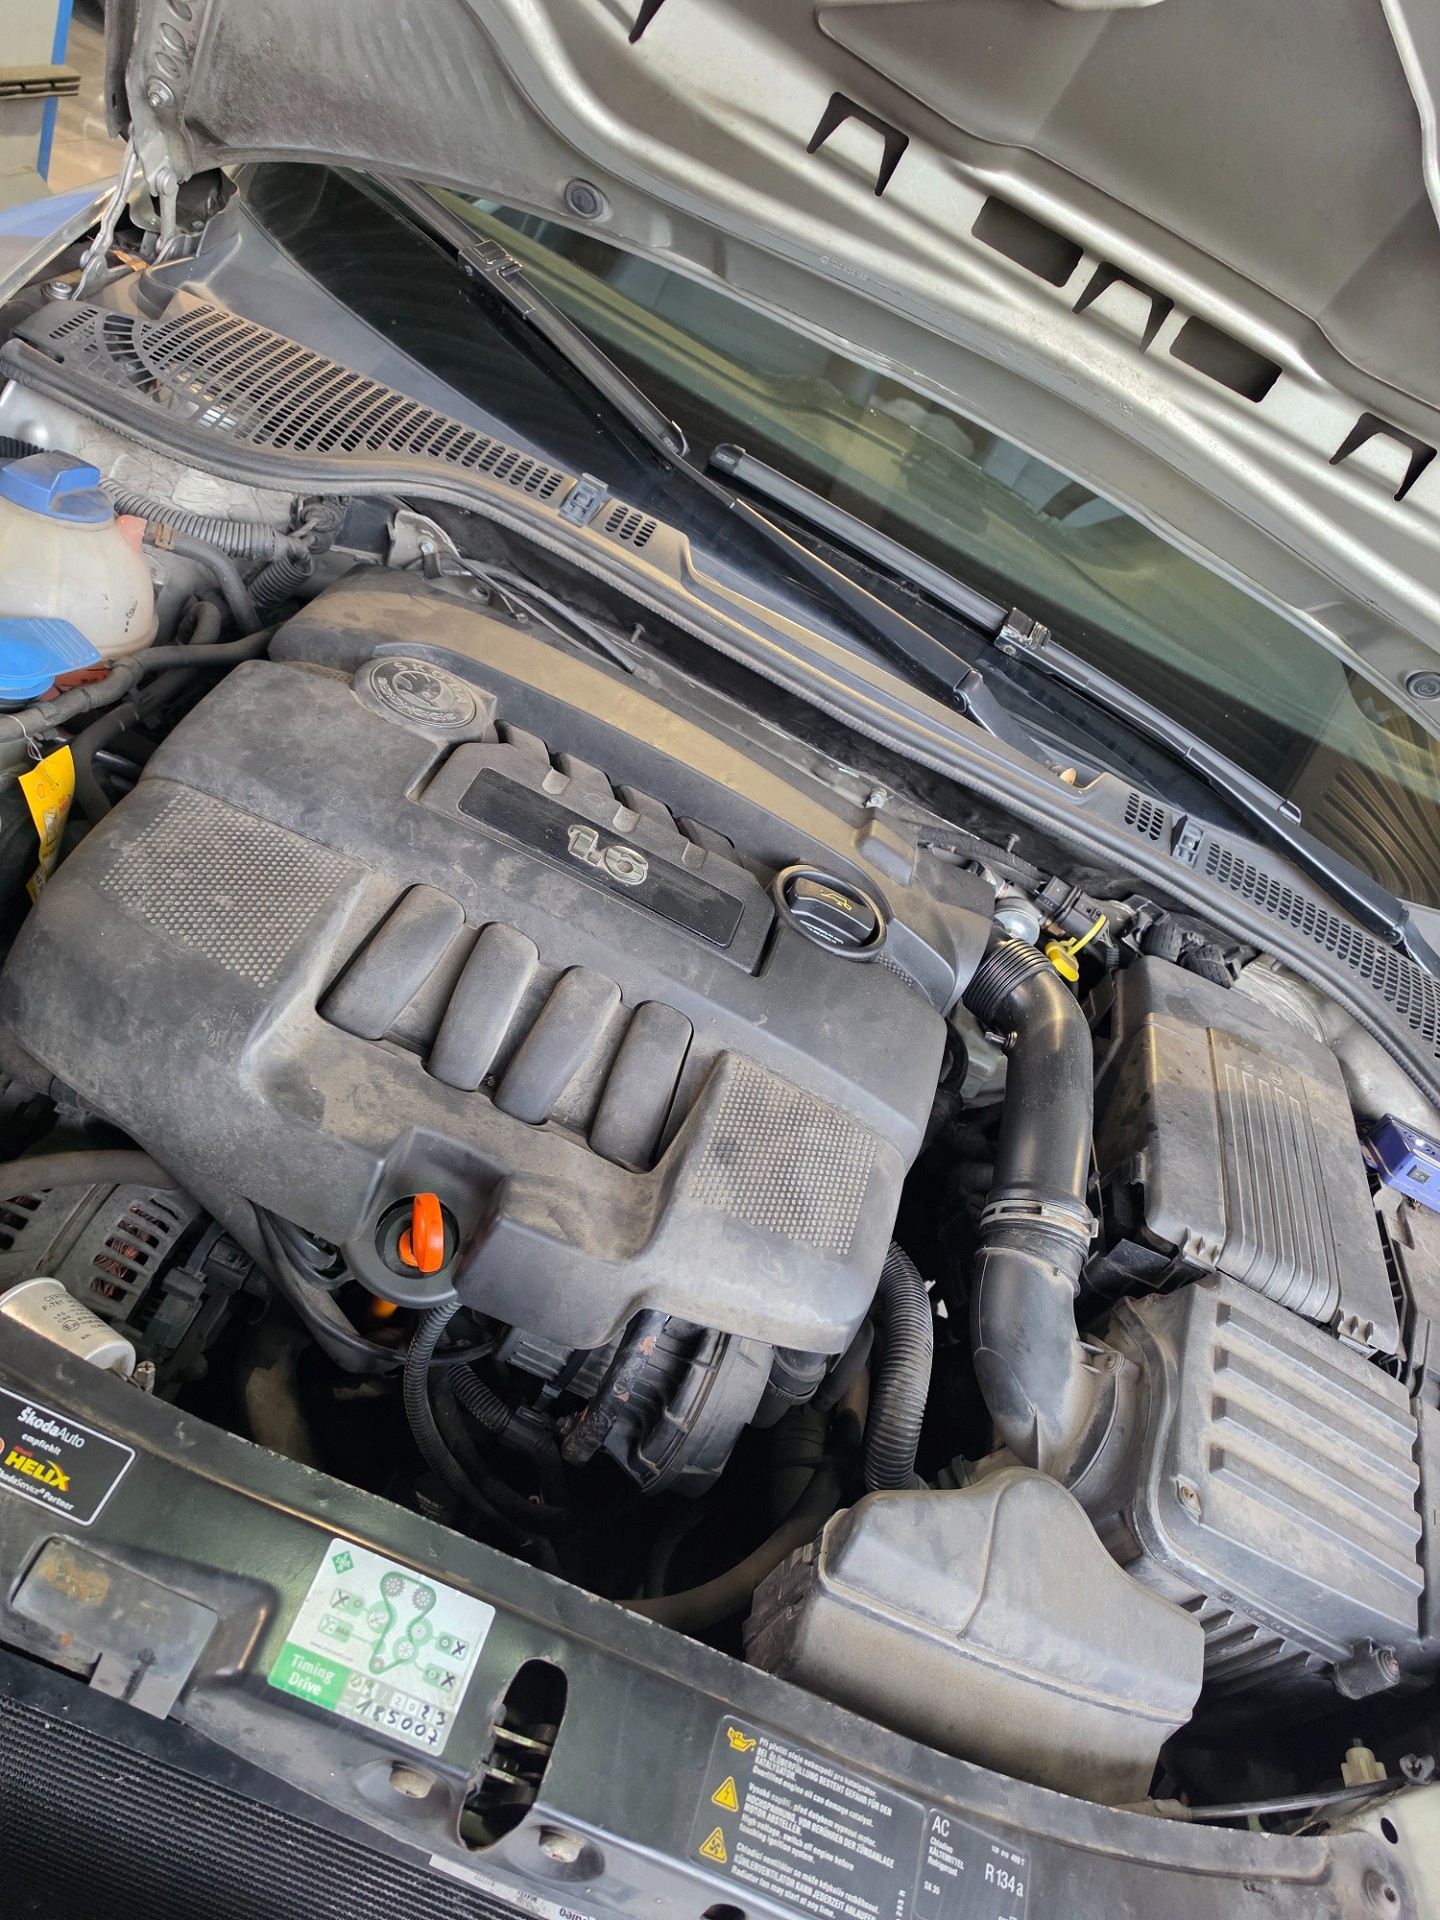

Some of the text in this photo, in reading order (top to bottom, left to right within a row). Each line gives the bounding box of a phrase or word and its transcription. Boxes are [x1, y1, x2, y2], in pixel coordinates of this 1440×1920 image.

[568, 824, 648, 885] 1.6
[21, 1433, 61, 1456] empfiehlt
[4, 1450, 70, 1493] HELIX
[43, 1491, 74, 1511] Partner
[288, 1671, 322, 1697] Drive
[292, 1653, 335, 1685] Timing
[356, 1700, 438, 1745] 185007
[754, 1754, 797, 1781] KATALYSATOR.
[756, 1746, 892, 1816] BEI ÖLÜBERFÜLLUNG BESTEHT GEFAHR FÜR DEN
[833, 1773, 843, 1782] pro
[744, 1802, 766, 1819] MOTOR
[752, 1764, 874, 1828] Overfilled engine oil can damage catalyst.
[797, 1816, 811, 1829] VOR
[843, 1837, 856, 1850] DER
[931, 1815, 950, 1837] AC
[739, 1822, 815, 1864] touching ignition system.
[741, 1812, 756, 1827] High
[783, 1831, 803, 1847] switch
[804, 1840, 812, 1851] off
[813, 1846, 833, 1862] engine
[834, 1855, 854, 1871] before
[927, 1855, 958, 1877] Refrigerant
[928, 1845, 965, 1870] KÄLTEMITTEL
[793, 1869, 800, 1878] se
[731, 1864, 758, 1883] Radiator
[759, 1877, 769, 1889] fan
[770, 1883, 782, 1896] may
[784, 1888, 799, 1902] start
[807, 1900, 817, 1911] any
[819, 1904, 836, 1919] time.
[795, 1880, 812, 1896] KANN
[813, 1889, 843, 1910] JEDERZEIT
